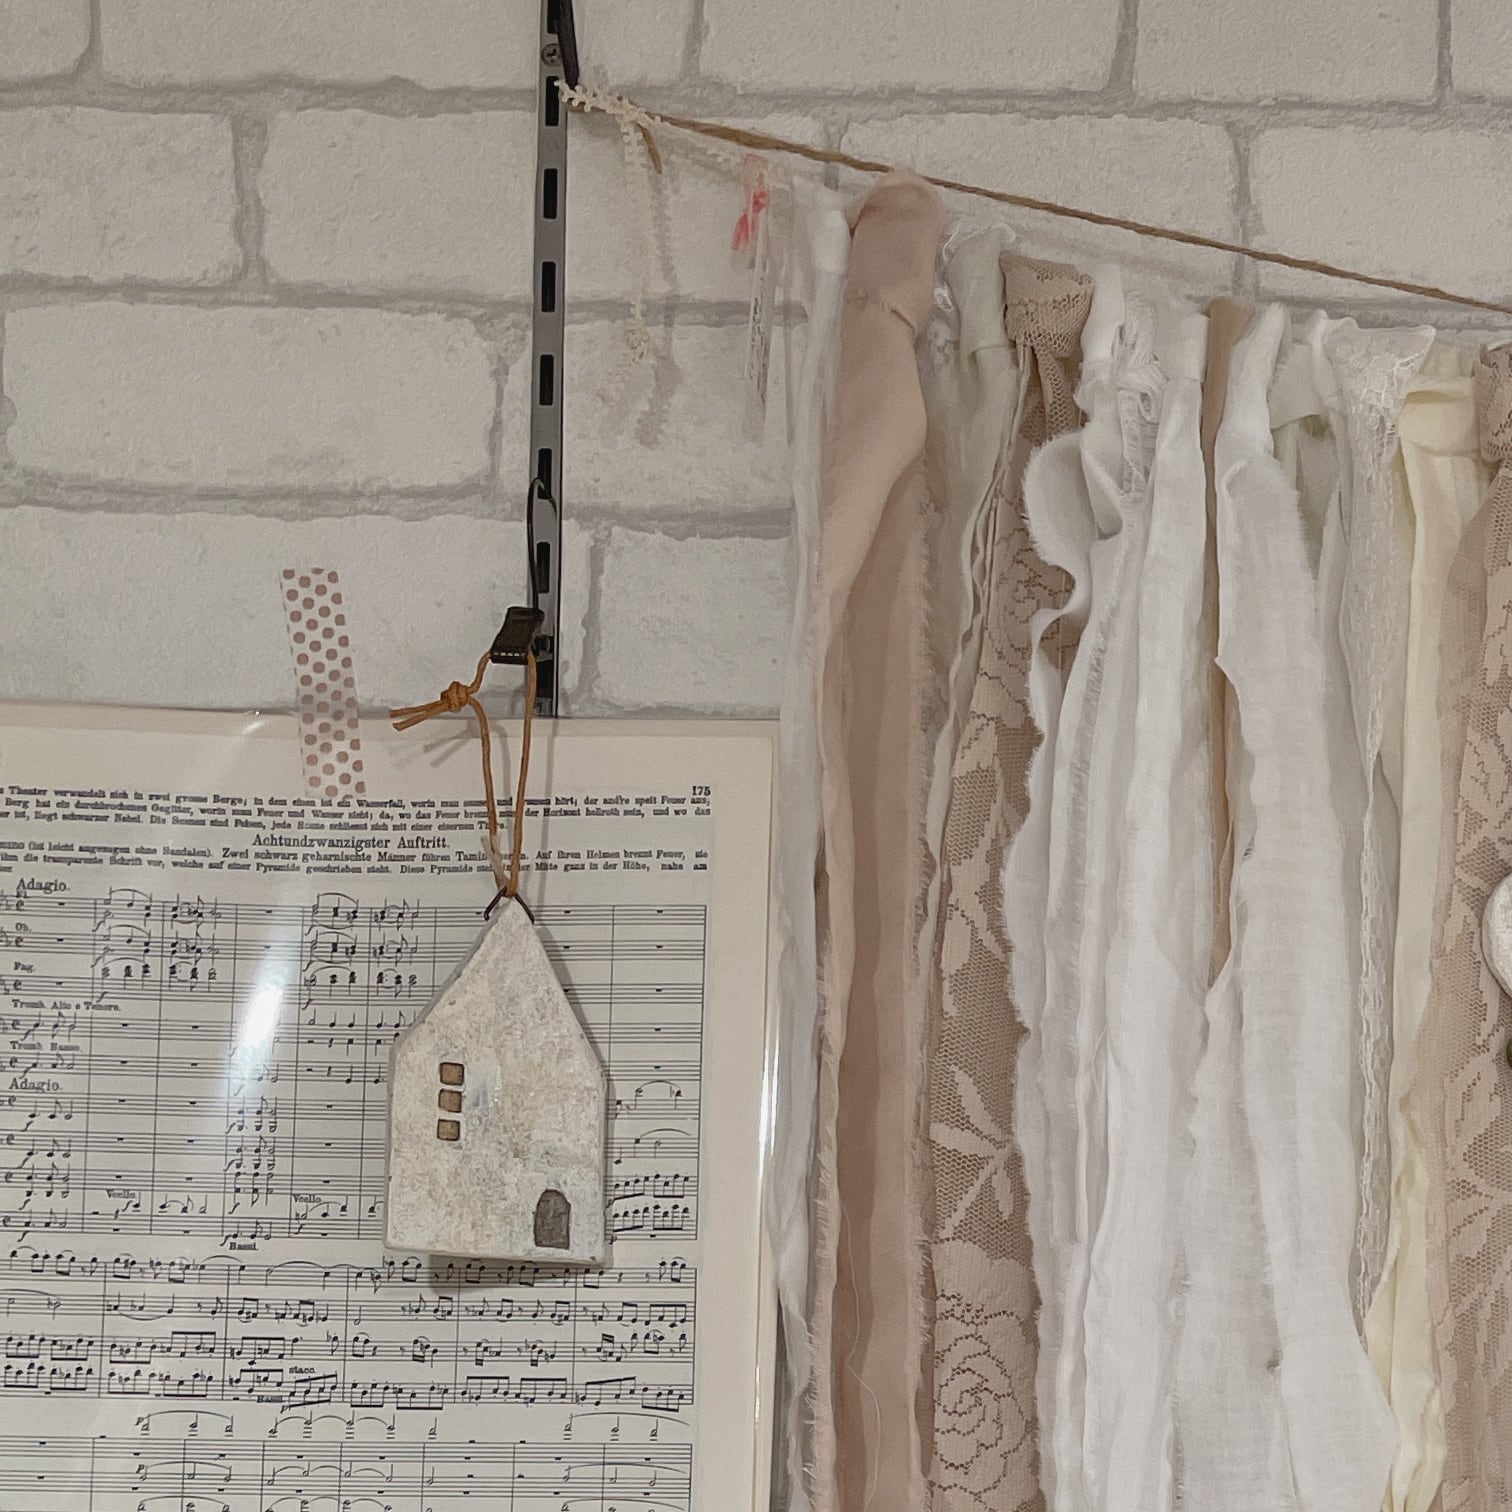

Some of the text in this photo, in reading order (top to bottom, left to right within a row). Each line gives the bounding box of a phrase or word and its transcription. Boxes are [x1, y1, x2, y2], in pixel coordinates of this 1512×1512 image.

[692, 786, 711, 796] 175
[252, 833, 450, 852] Achtundzwanzigster Auftritt.
[222, 847, 249, 859] Zwei
[254, 850, 298, 860] schwarz
[302, 851, 372, 862] geharnischte
[16, 878, 70, 894] Adagio.
[9, 1078, 62, 1092] Adagio.
